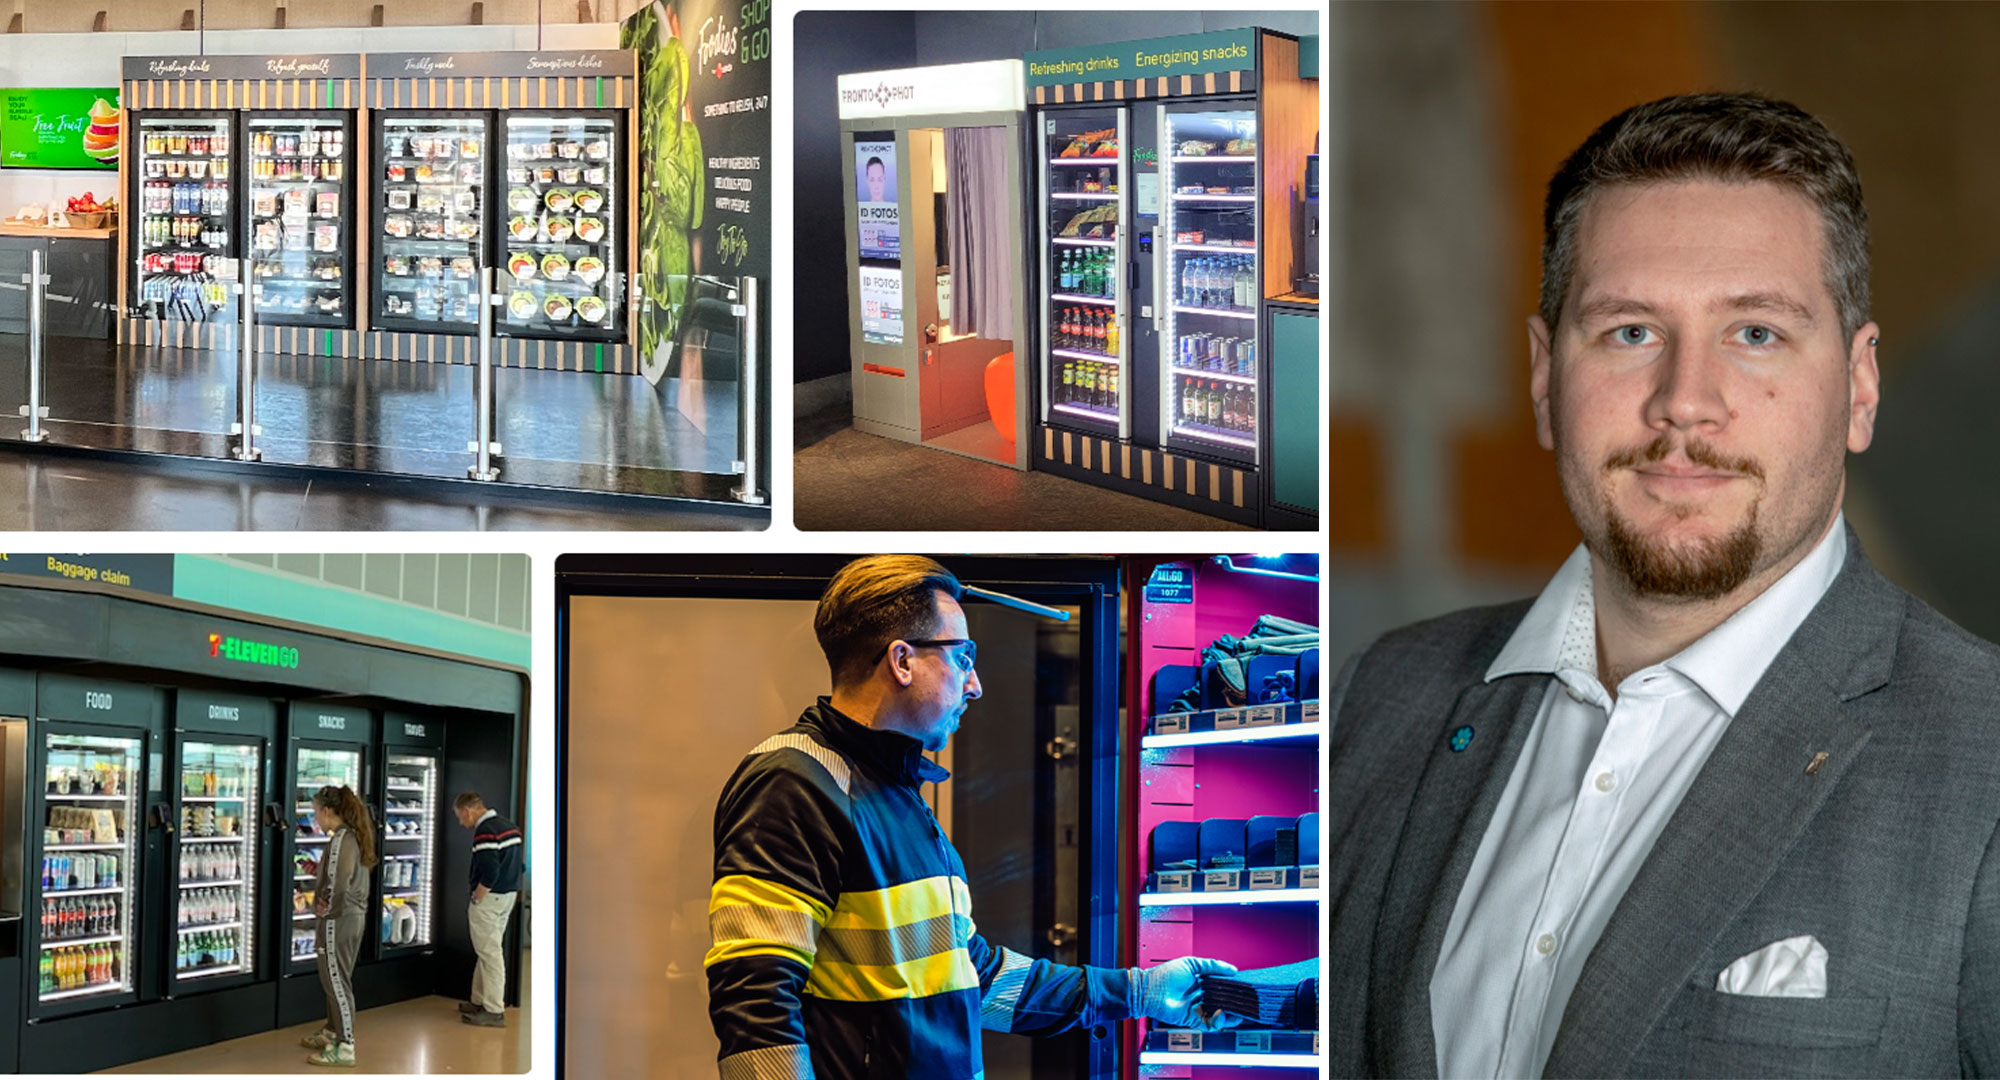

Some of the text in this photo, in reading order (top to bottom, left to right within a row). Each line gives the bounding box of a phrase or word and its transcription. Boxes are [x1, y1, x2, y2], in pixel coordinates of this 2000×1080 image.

[741, 0, 770, 29] SHOP
[698, 15, 738, 76] Foodies
[752, 27, 770, 61] GO
[1135, 42, 1248, 68] Energizing snacks
[1029, 56, 1120, 76] Refreshing drinks
[841, 88, 874, 103] PRONTO
[860, 207, 898, 219] ID FOTOS
[863, 276, 900, 290] ID FOTOS
[46, 556, 131, 586] Baggage claim
[1161, 588, 1180, 597] 1077
[279, 645, 299, 669] GO
[86, 692, 112, 710] FOOD
[209, 705, 239, 721] DRINKS
[318, 714, 345, 730] SNACKS
[404, 722, 426, 737] TRAVEL
